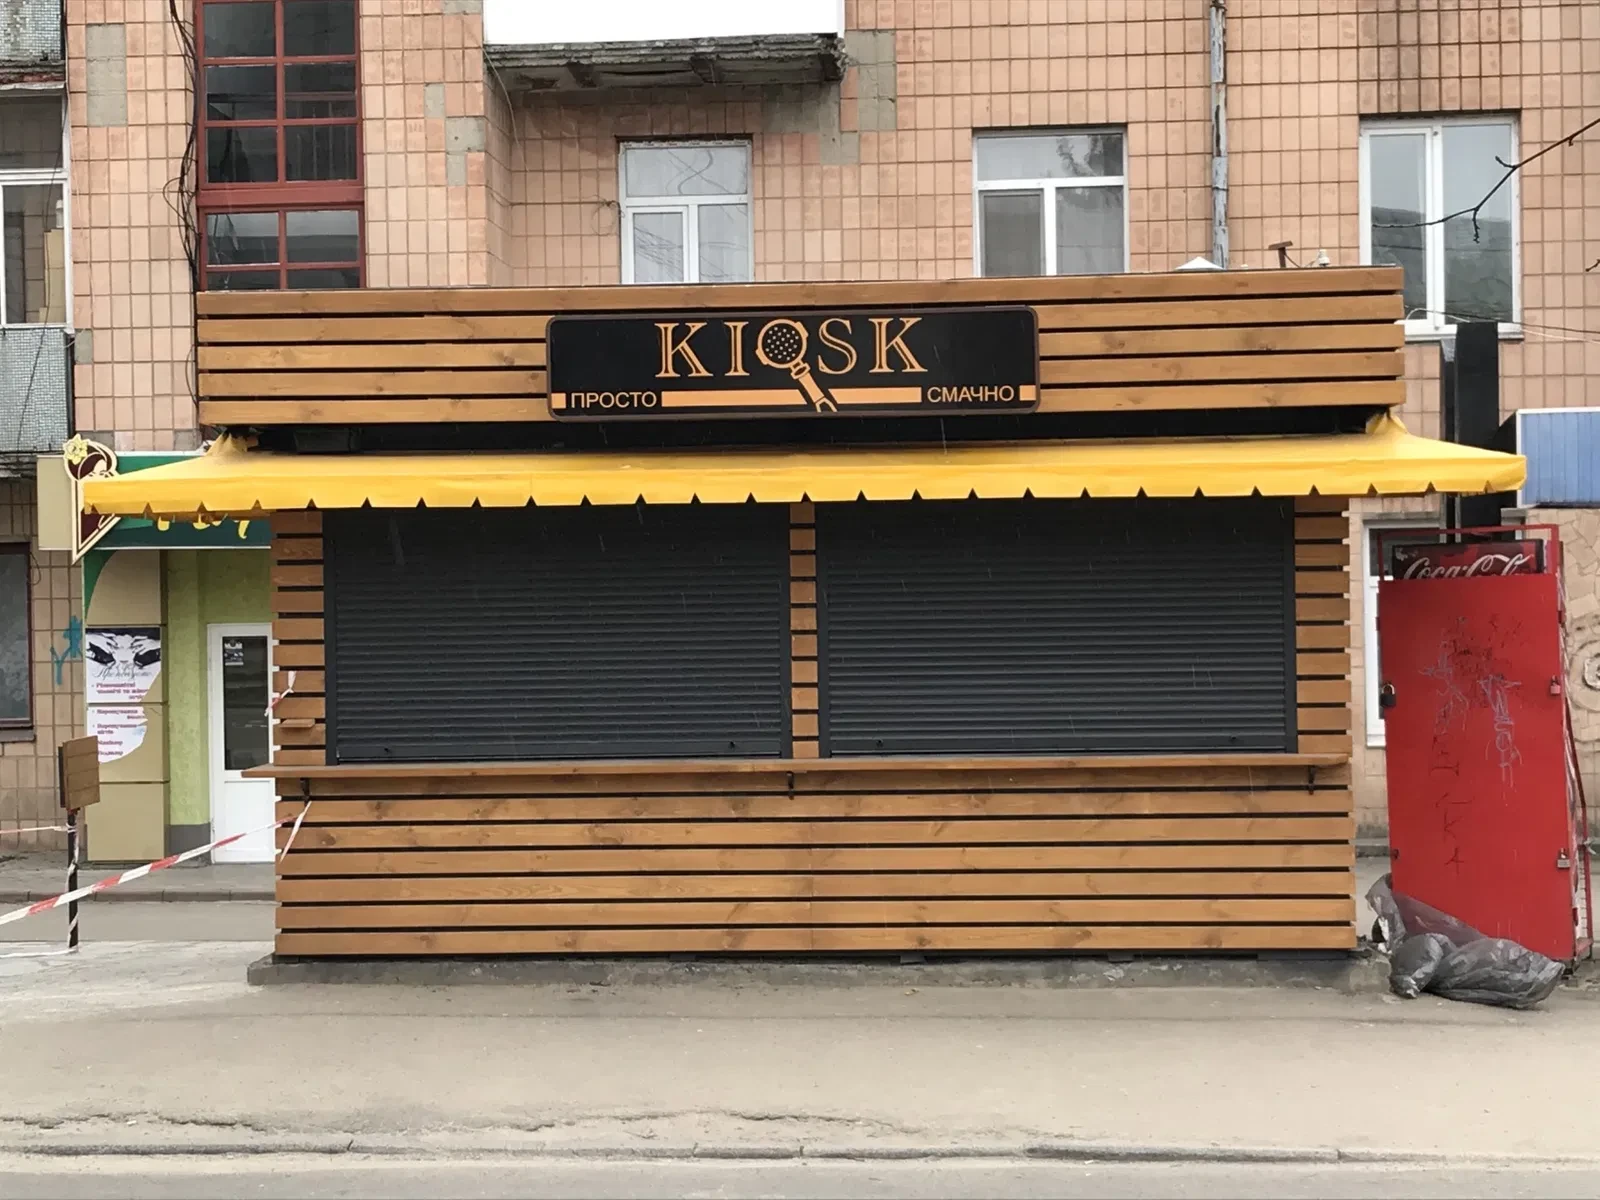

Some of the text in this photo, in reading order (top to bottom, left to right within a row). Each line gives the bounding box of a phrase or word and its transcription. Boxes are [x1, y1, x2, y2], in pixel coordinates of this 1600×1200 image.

[654, 316, 928, 378] KIOSK
[571, 385, 1015, 408] ПРОСТО СМАЧНО
